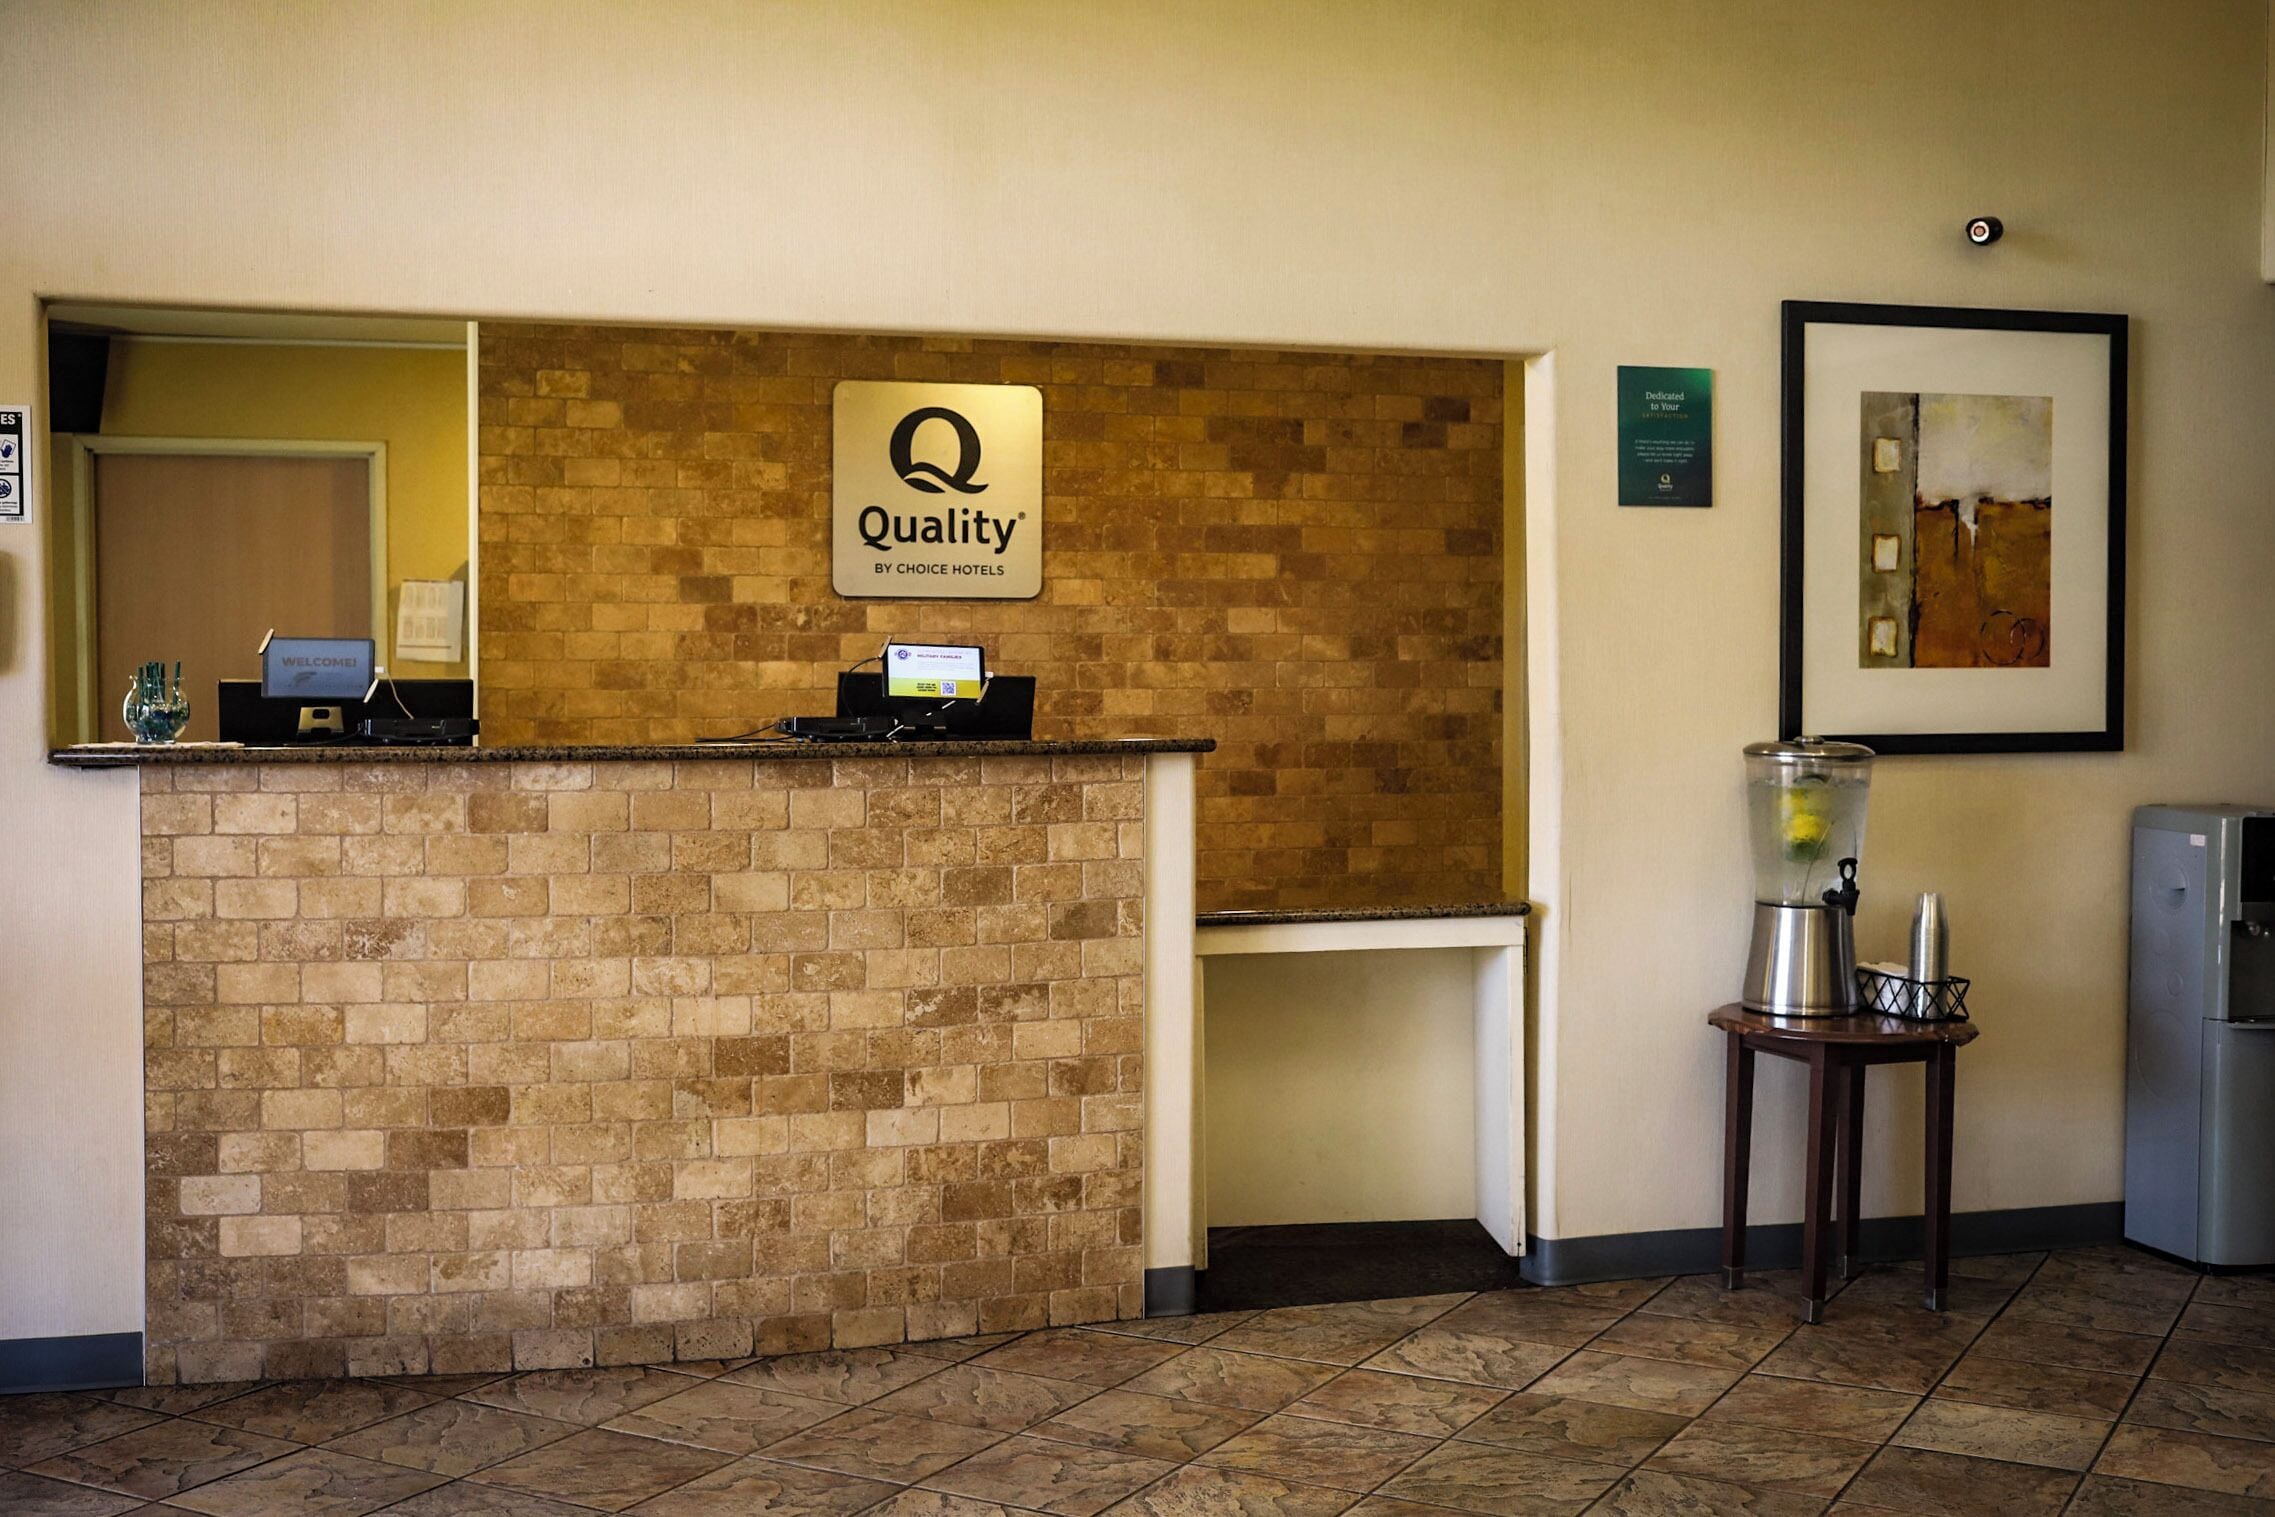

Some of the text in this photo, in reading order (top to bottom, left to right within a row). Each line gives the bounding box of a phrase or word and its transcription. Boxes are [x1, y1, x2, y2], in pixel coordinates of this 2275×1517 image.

[1645, 391, 1685, 401] Dedicated
[1651, 401, 1680, 411] to Your
[875, 563, 1005, 576] BY CHOICE HOTELS
[282, 656, 357, 668] WELCOME!
